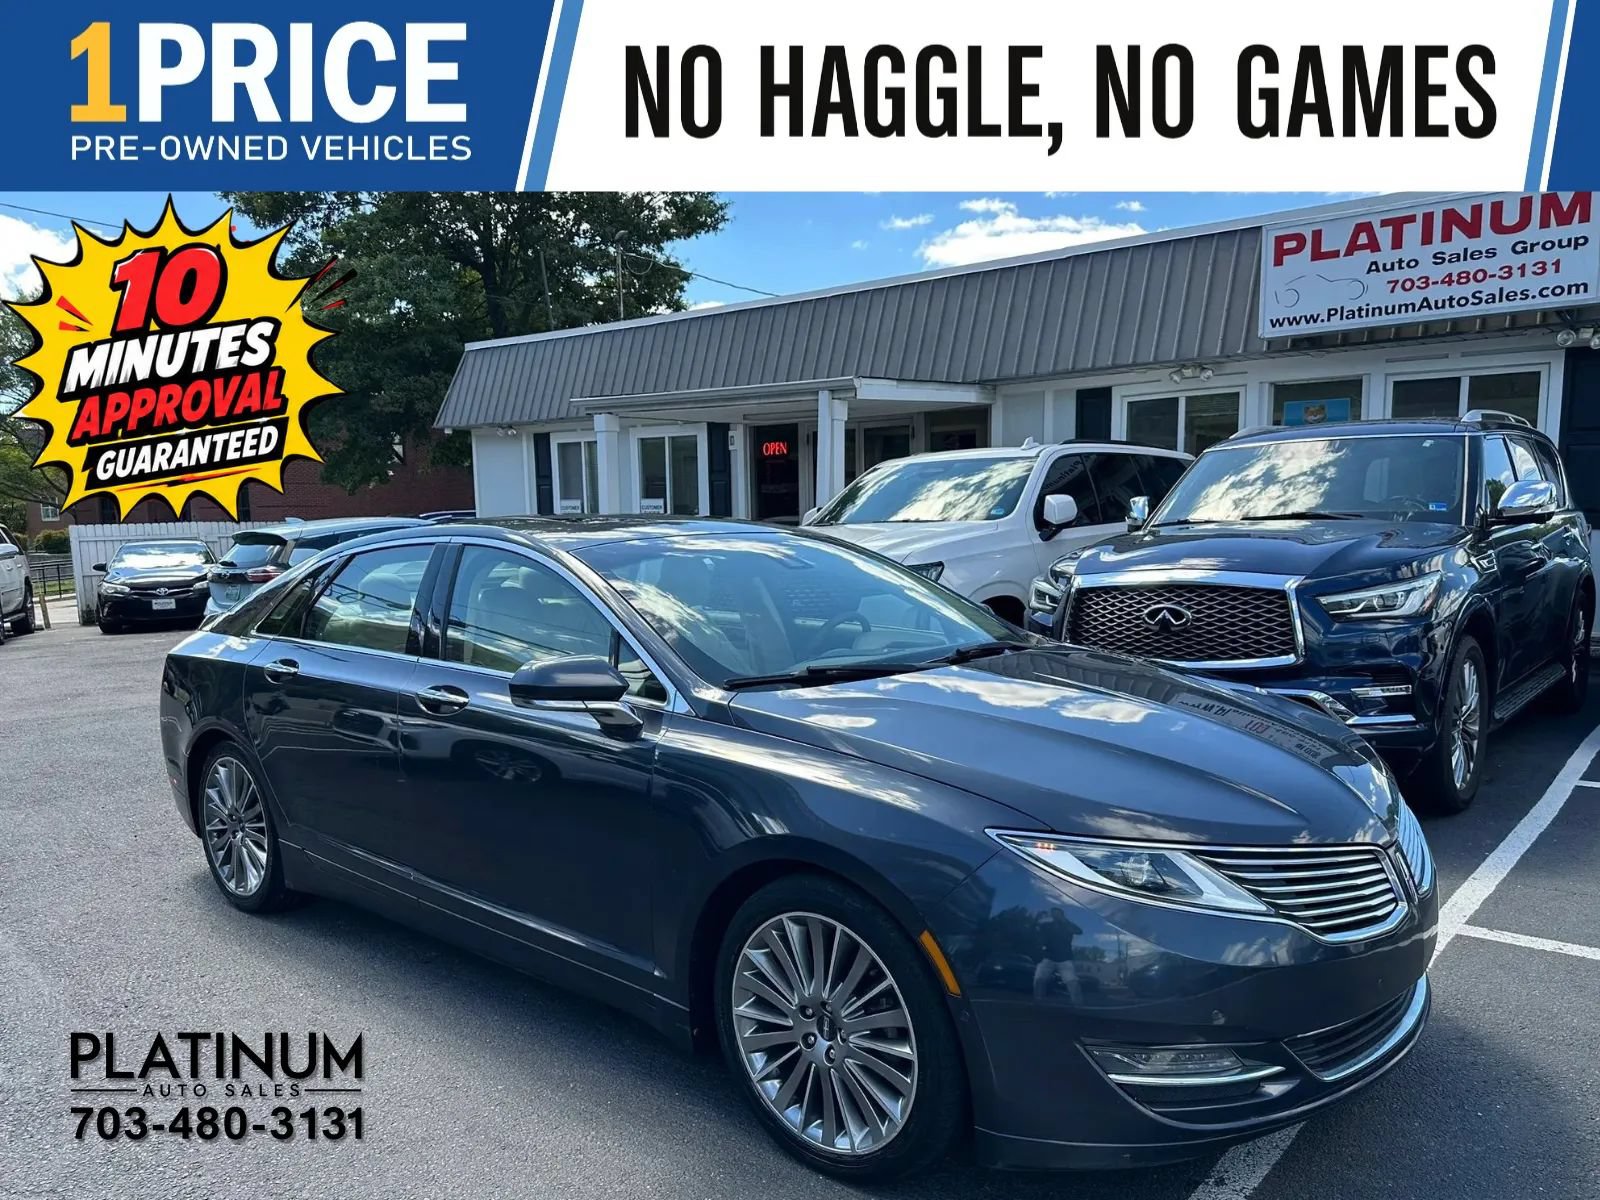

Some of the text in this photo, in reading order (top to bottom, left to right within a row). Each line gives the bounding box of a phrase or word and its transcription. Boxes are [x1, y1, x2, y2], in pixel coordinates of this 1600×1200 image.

[1273, 191, 1592, 267] PLATINUM
[1366, 234, 1590, 275] Auto Sales Group
[1386, 258, 1562, 294] 703-480-3131
[1269, 281, 1590, 329] www.PlatinumAutoSales.com
[762, 441, 788, 456] OPEN
